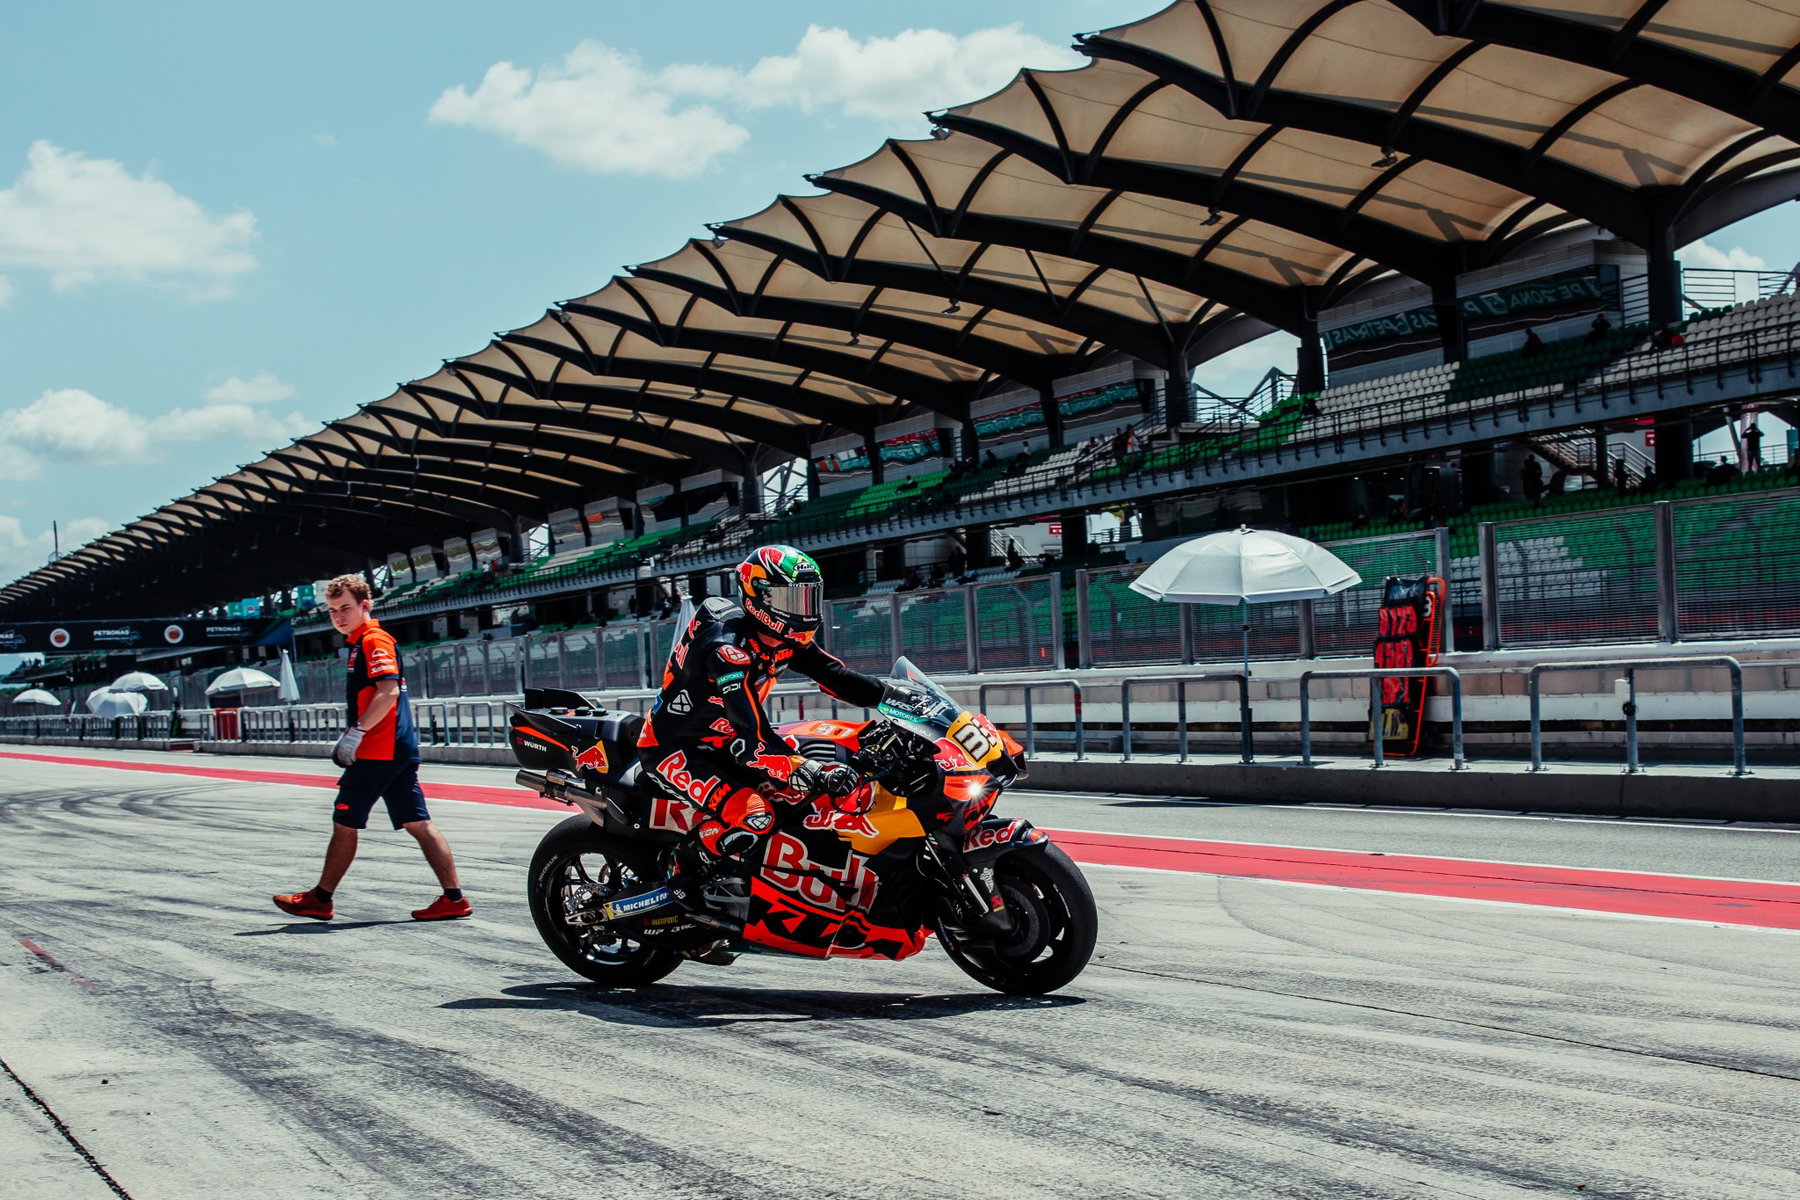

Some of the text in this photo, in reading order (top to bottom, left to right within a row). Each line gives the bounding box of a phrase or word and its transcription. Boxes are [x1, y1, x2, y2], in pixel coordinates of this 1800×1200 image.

[93, 629, 130, 638] PETRONAS
[206, 626, 241, 634] PETRONAS
[889, 708, 918, 722] MOTOREX
[656, 749, 722, 807] Red
[707, 783, 732, 812] KTM
[963, 821, 1018, 853] Red
[760, 829, 880, 914] Bull
[622, 892, 668, 912] MICHELIN
